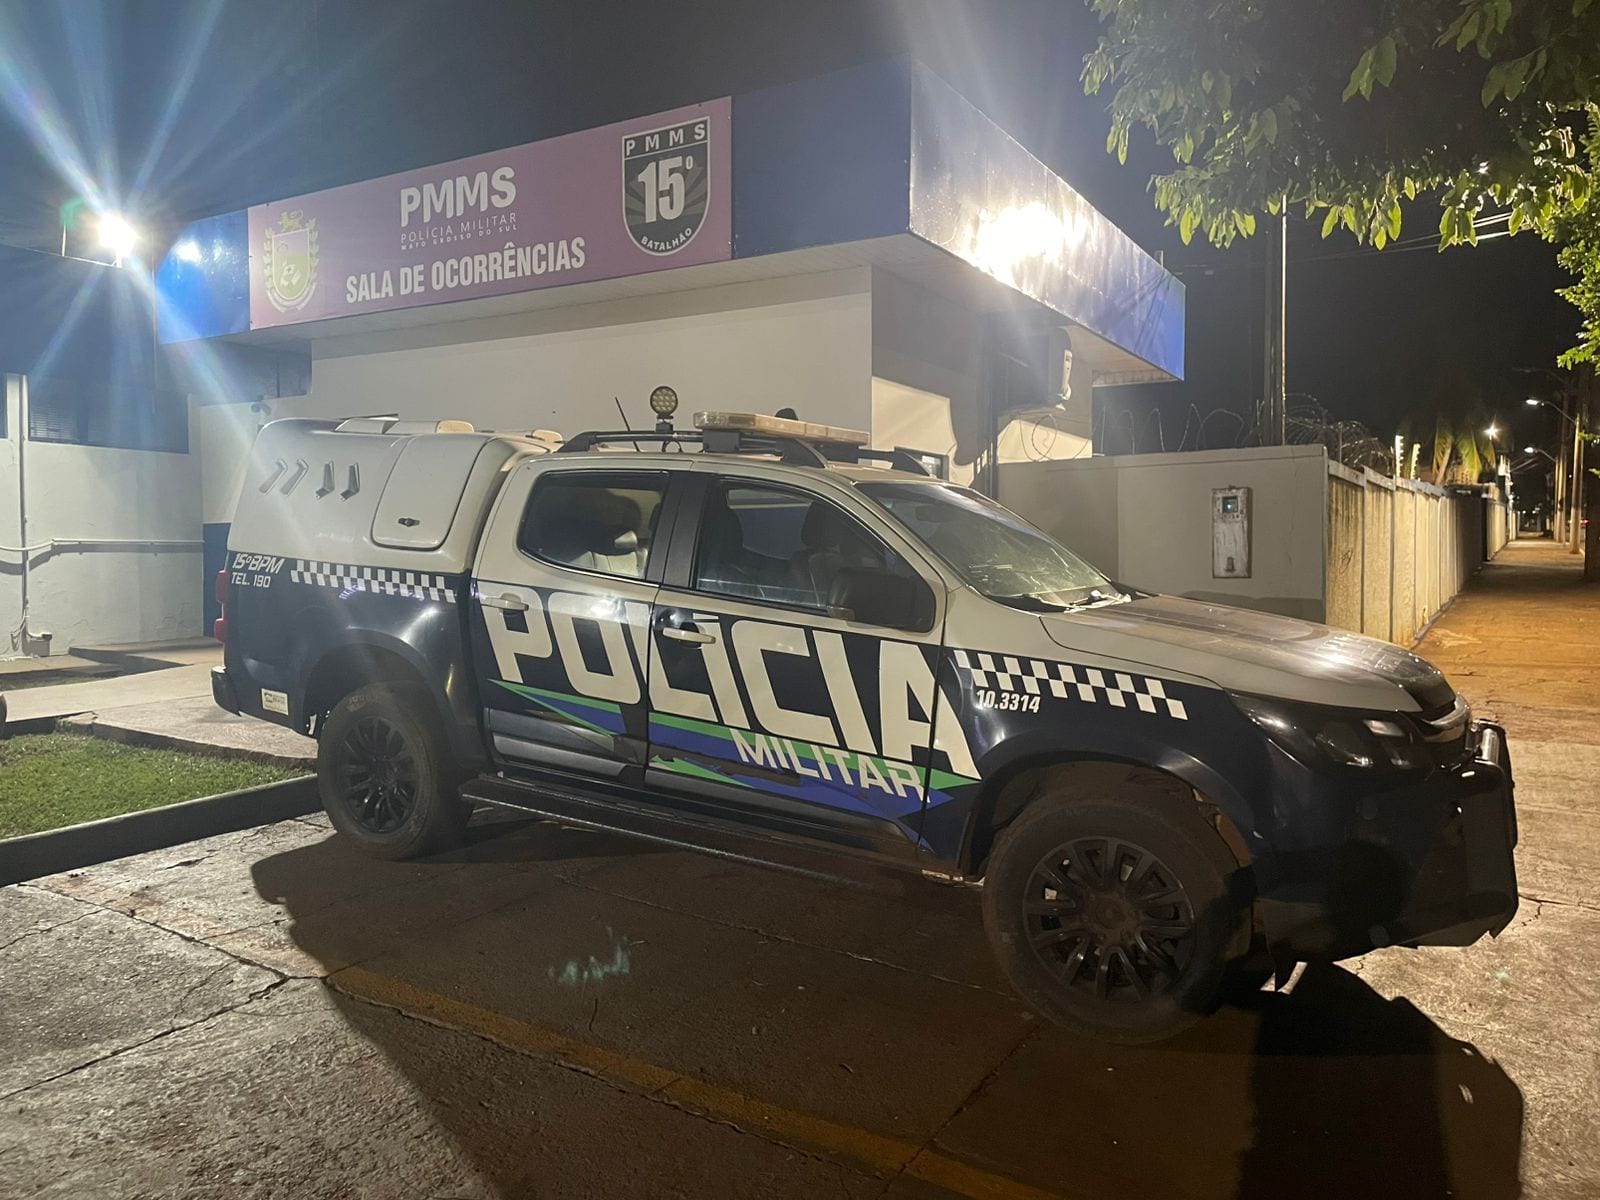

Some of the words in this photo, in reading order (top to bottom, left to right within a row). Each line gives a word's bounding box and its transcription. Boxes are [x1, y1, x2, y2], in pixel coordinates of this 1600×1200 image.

[626, 123, 706, 156] PMMS
[401, 166, 517, 227] PMMS
[401, 225, 453, 244] POLÍCIA
[461, 212, 517, 233] MILITAR
[401, 240, 427, 250] MATO
[433, 233, 472, 246] GROSSO
[479, 228, 492, 238] DO
[499, 224, 518, 234] SUL
[640, 227, 693, 250] BATALHÃO
[346, 270, 394, 304] SALA
[400, 264, 425, 295] DE
[431, 237, 586, 291] OCORRÊNCIAS
[231, 572, 250, 586] TEL.
[253, 574, 271, 588] 190
[479, 581, 982, 780] POLÍCIA
[976, 689, 1041, 713] 10.3314
[729, 728, 931, 804] MILITAR
